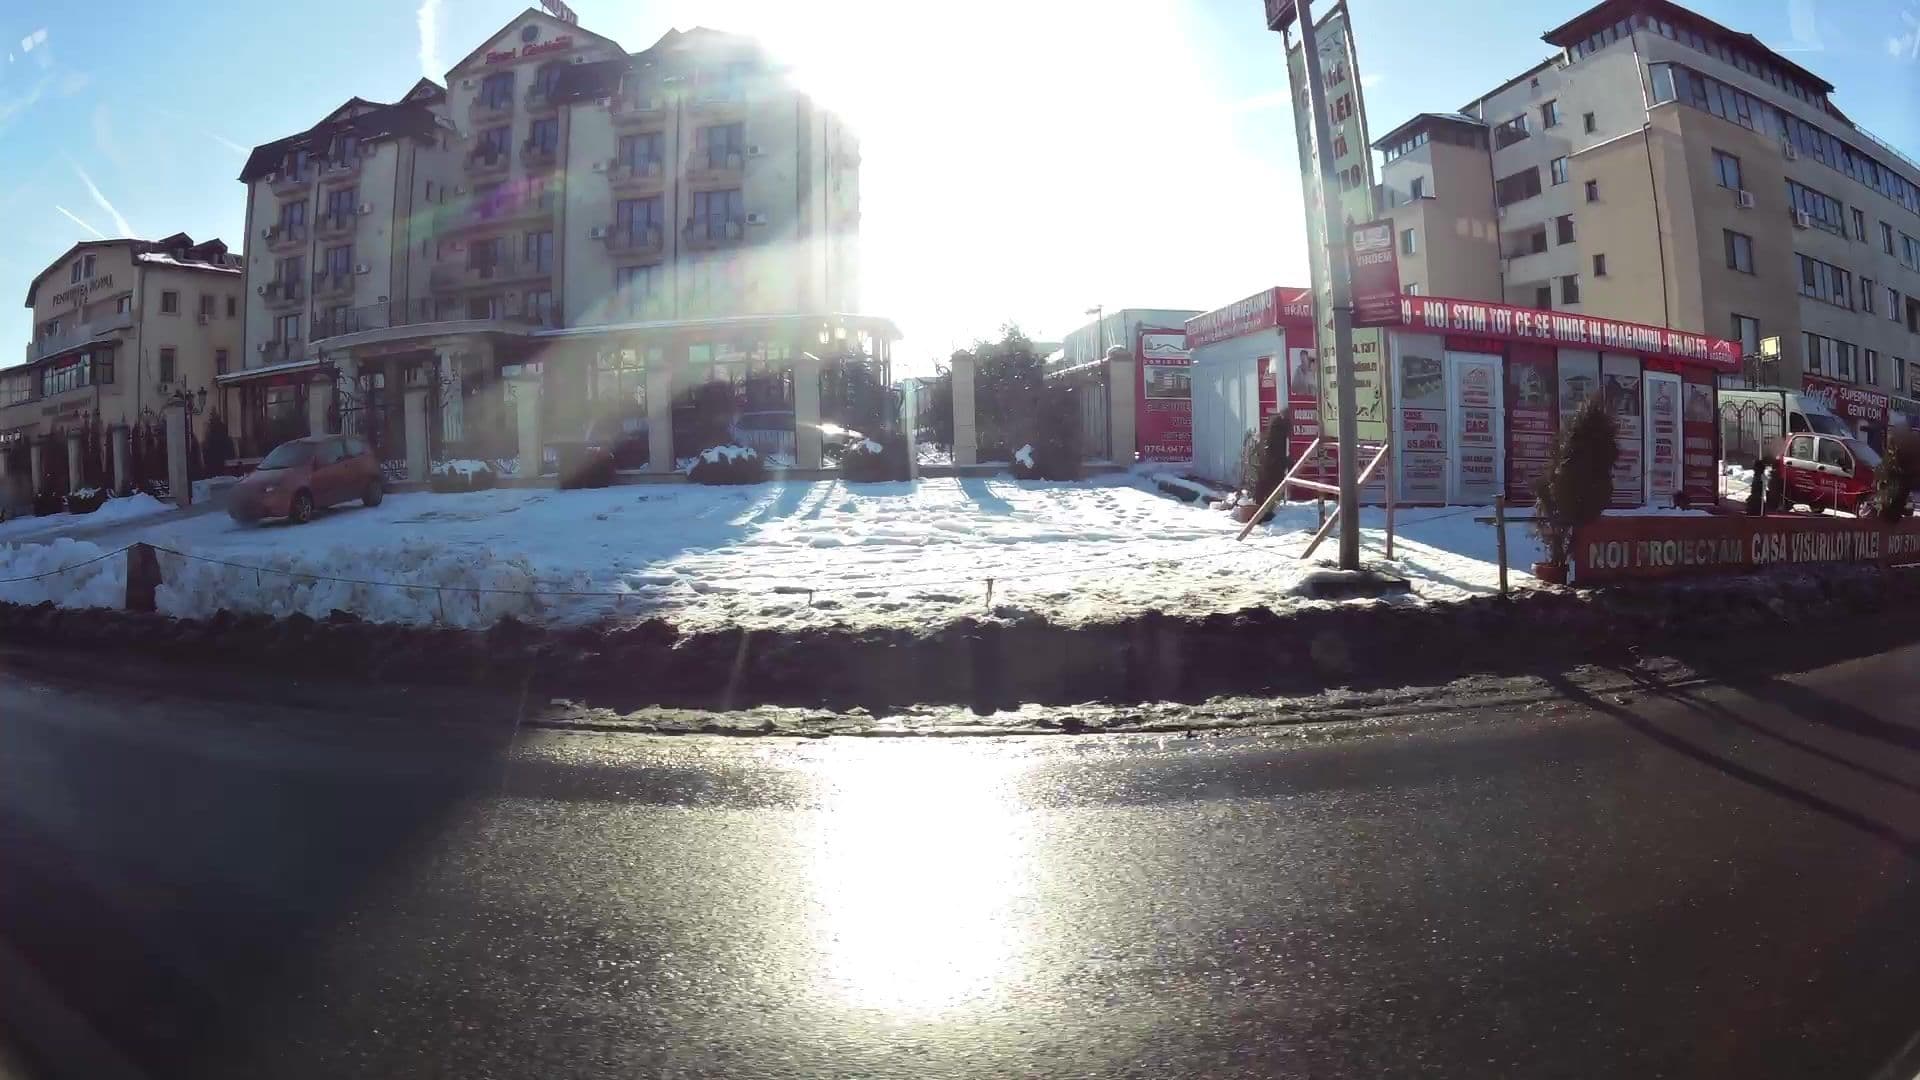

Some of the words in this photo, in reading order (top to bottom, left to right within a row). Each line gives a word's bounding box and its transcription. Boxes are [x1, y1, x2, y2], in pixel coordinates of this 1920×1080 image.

[1424, 301, 1449, 328] NOI
[1489, 307, 1512, 335] TOT
[1534, 313, 1551, 338] SE
[1552, 315, 1587, 343] VINDE
[1589, 541, 1628, 568] NOI
[1751, 532, 1787, 564] CASA
[1854, 531, 1880, 561] TALE!
[1888, 535, 1903, 554] NOI
